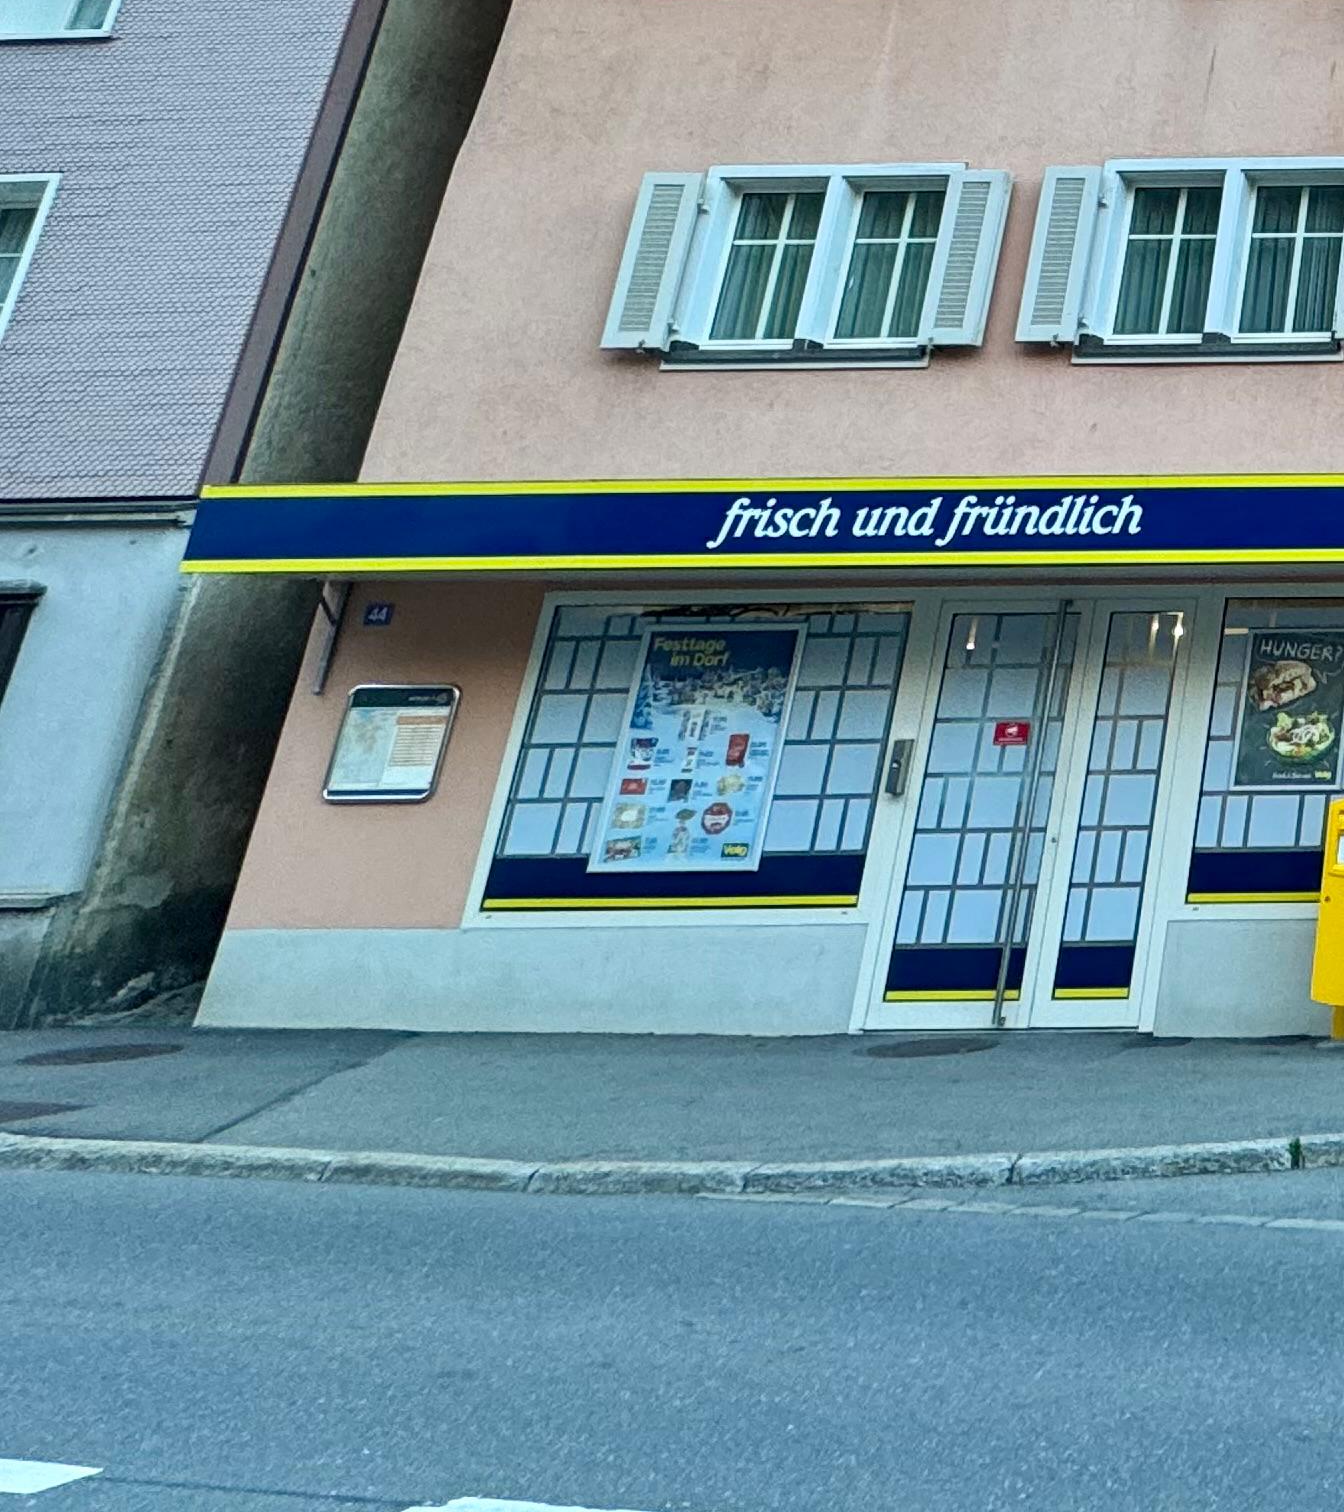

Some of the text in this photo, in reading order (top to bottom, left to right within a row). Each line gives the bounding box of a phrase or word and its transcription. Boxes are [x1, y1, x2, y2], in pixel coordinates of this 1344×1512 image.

[706, 494, 1143, 549] frisch und fründlich
[368, 607, 388, 621] 44
[1260, 639, 1344, 662] HUNGER?
